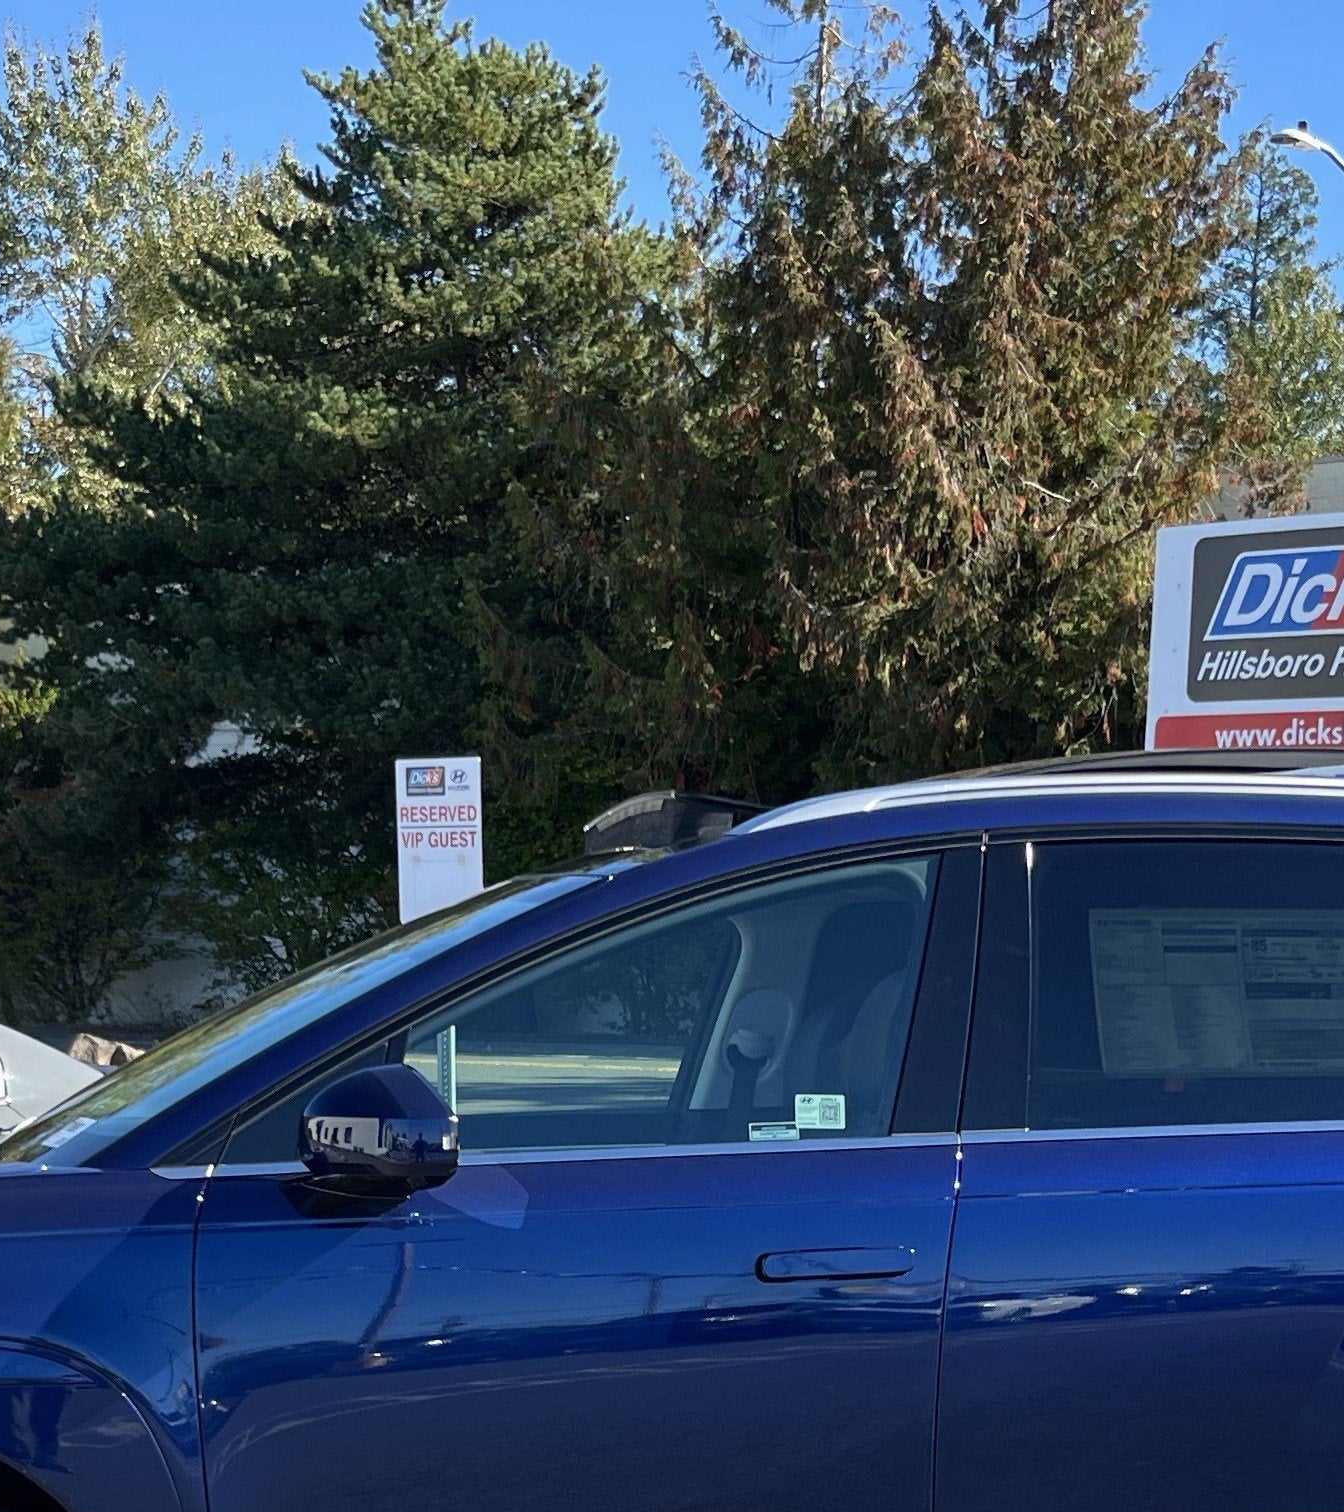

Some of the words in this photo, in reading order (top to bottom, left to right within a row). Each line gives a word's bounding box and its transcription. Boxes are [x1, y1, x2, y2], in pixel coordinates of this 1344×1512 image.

[1197, 649, 1325, 682] Hillsboro
[400, 805, 477, 823] RESERVED
[401, 831, 423, 848] VIP
[428, 831, 477, 848] GUEST
